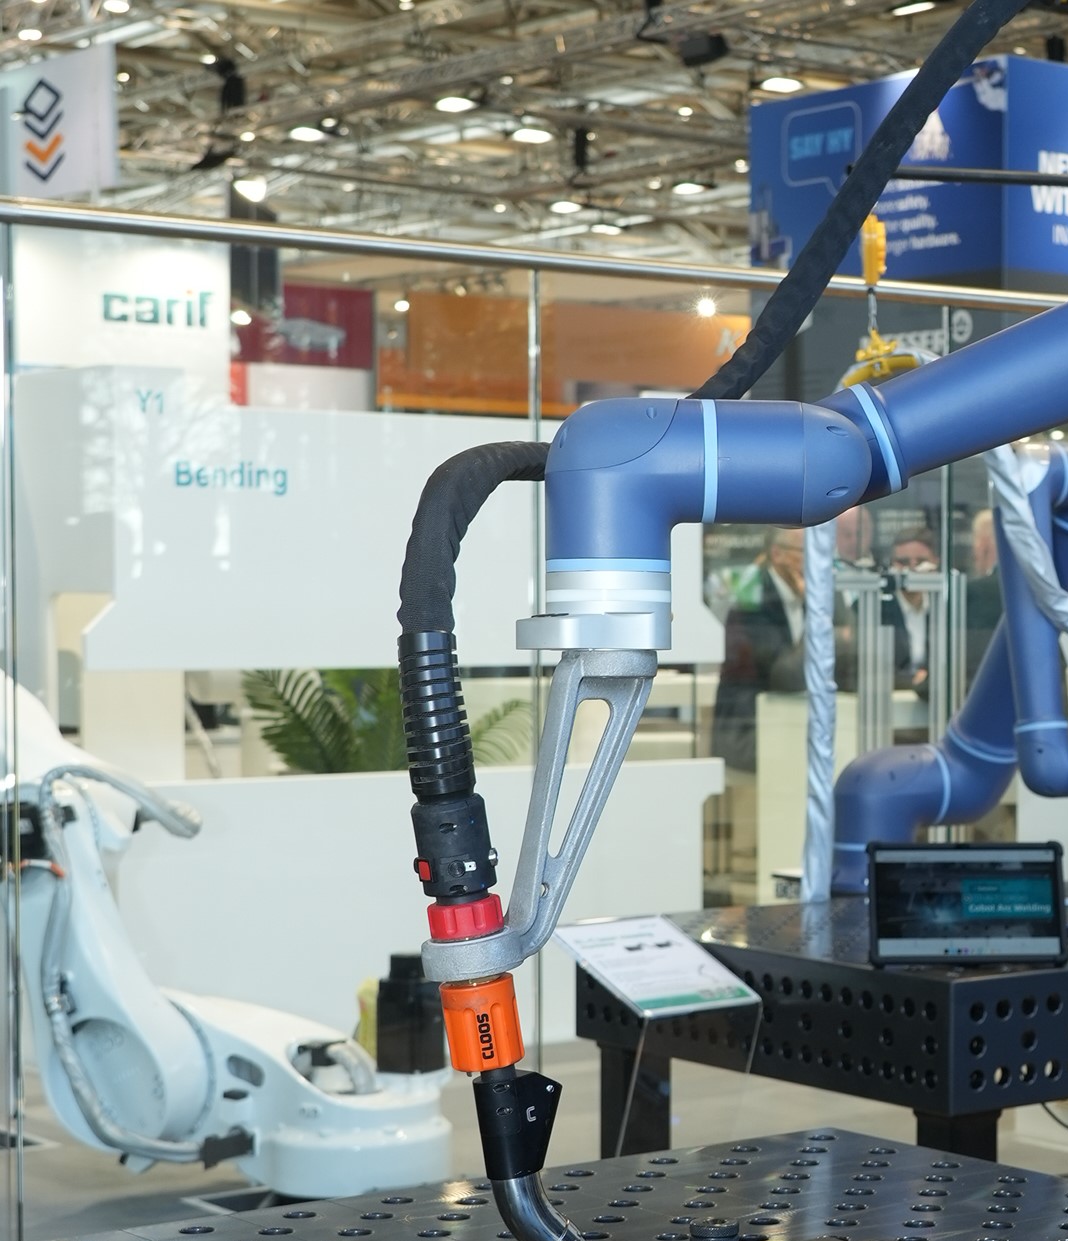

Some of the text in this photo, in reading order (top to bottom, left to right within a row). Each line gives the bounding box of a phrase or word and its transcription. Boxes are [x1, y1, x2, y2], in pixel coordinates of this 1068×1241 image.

[103, 289, 214, 327] carif
[175, 461, 288, 496] Bending
[477, 1013, 495, 1060] CLOOS
